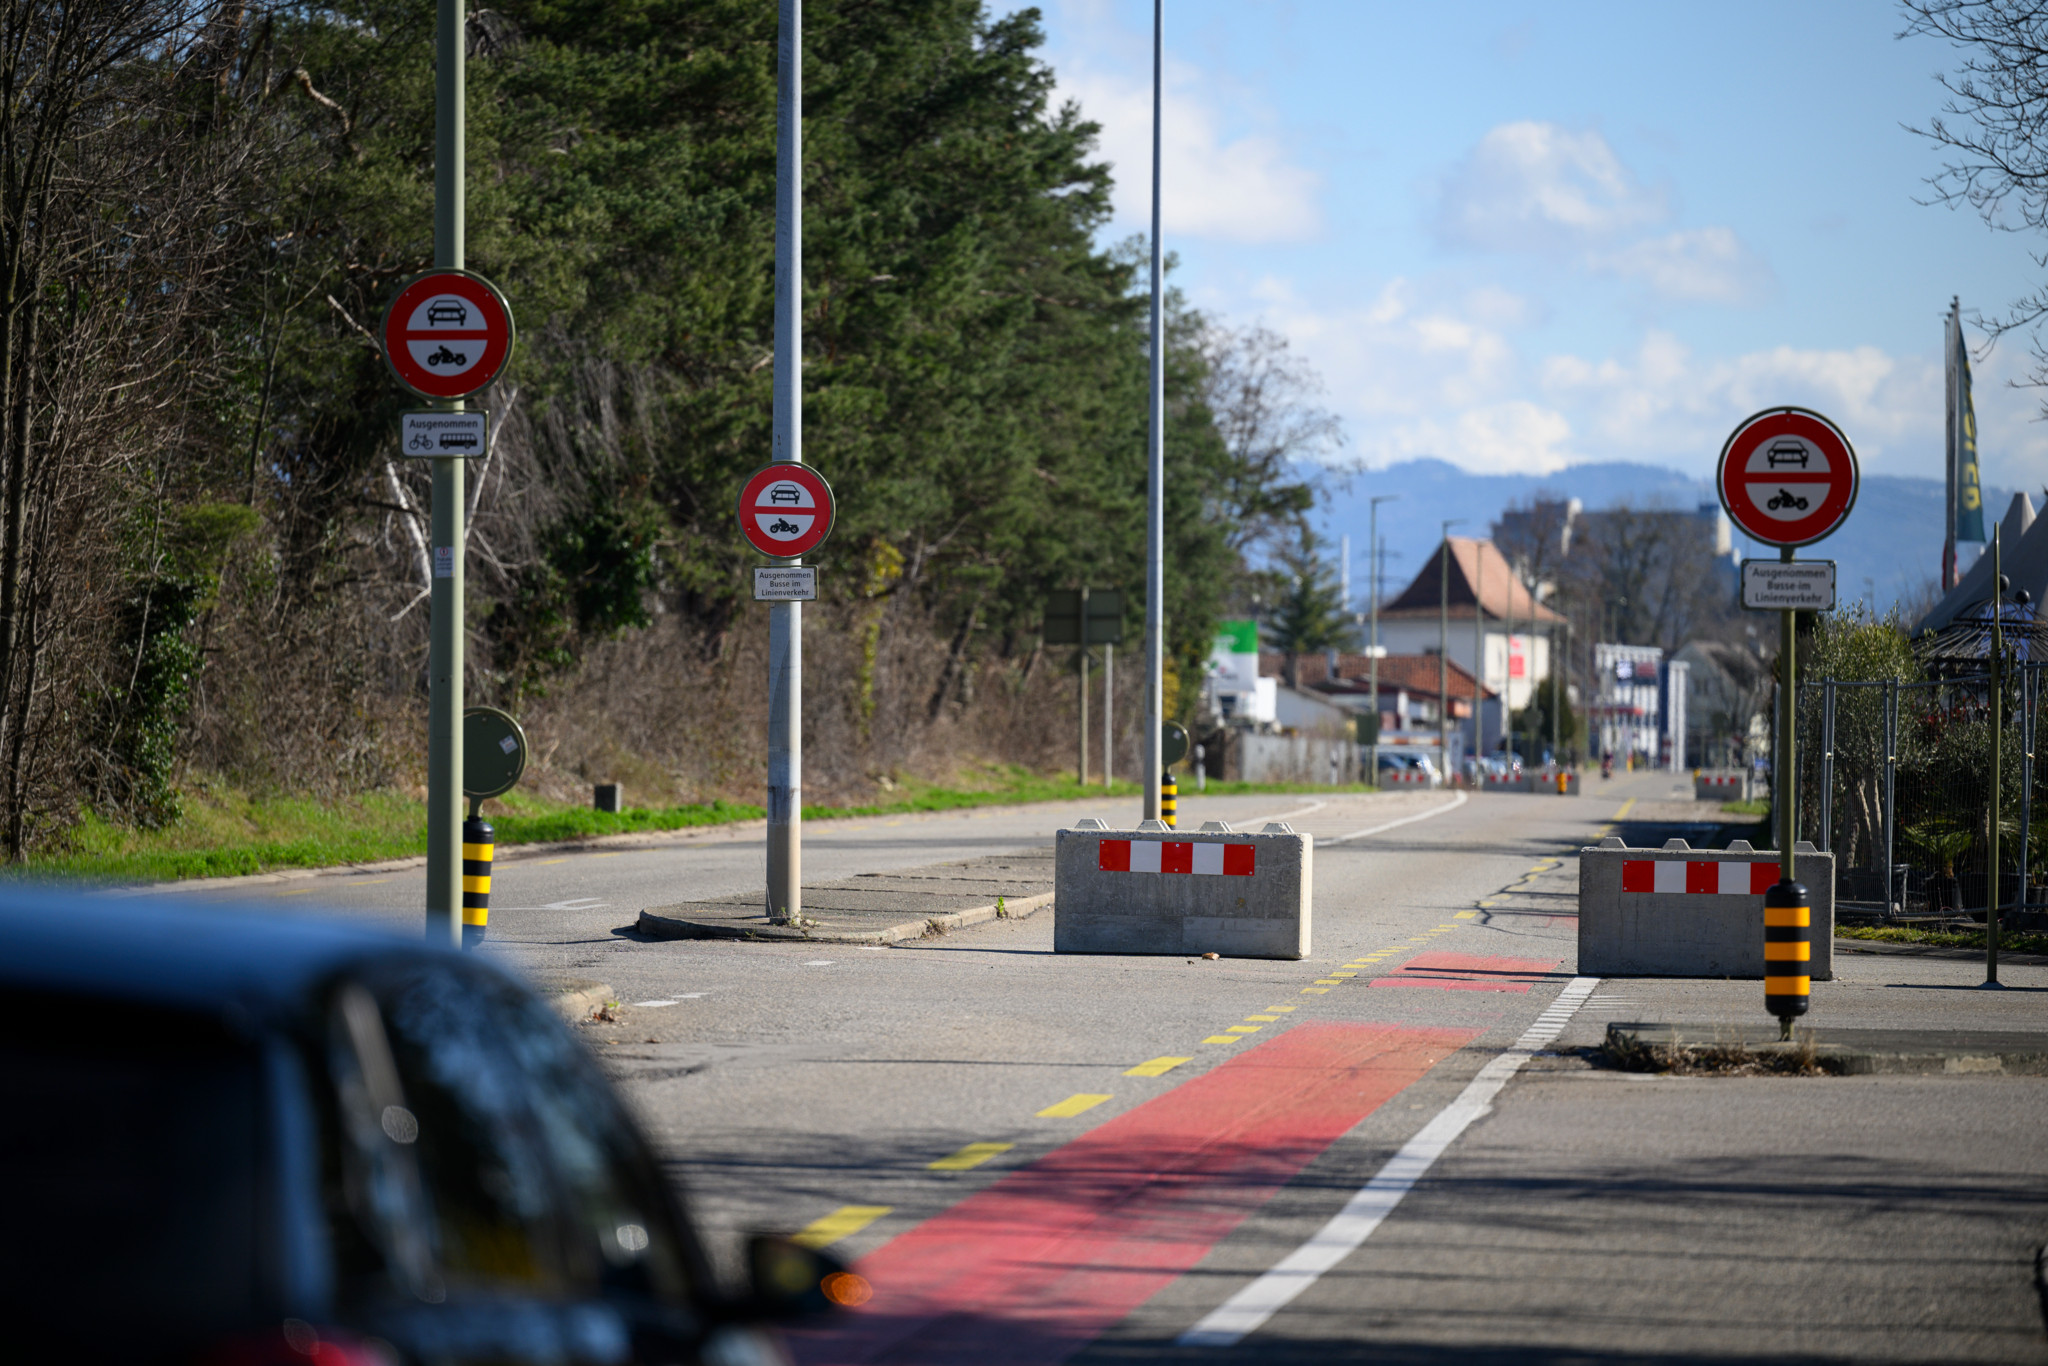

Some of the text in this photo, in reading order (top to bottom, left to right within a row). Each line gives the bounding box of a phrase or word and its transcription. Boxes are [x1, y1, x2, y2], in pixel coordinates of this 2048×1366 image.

[409, 419, 478, 431] Ausgenommen
[759, 572, 811, 580] Ausgenommen
[1752, 567, 1826, 579] Ausgenommen
[1767, 580, 1811, 590] Busse im
[1755, 592, 1823, 604] Linienverkehr
